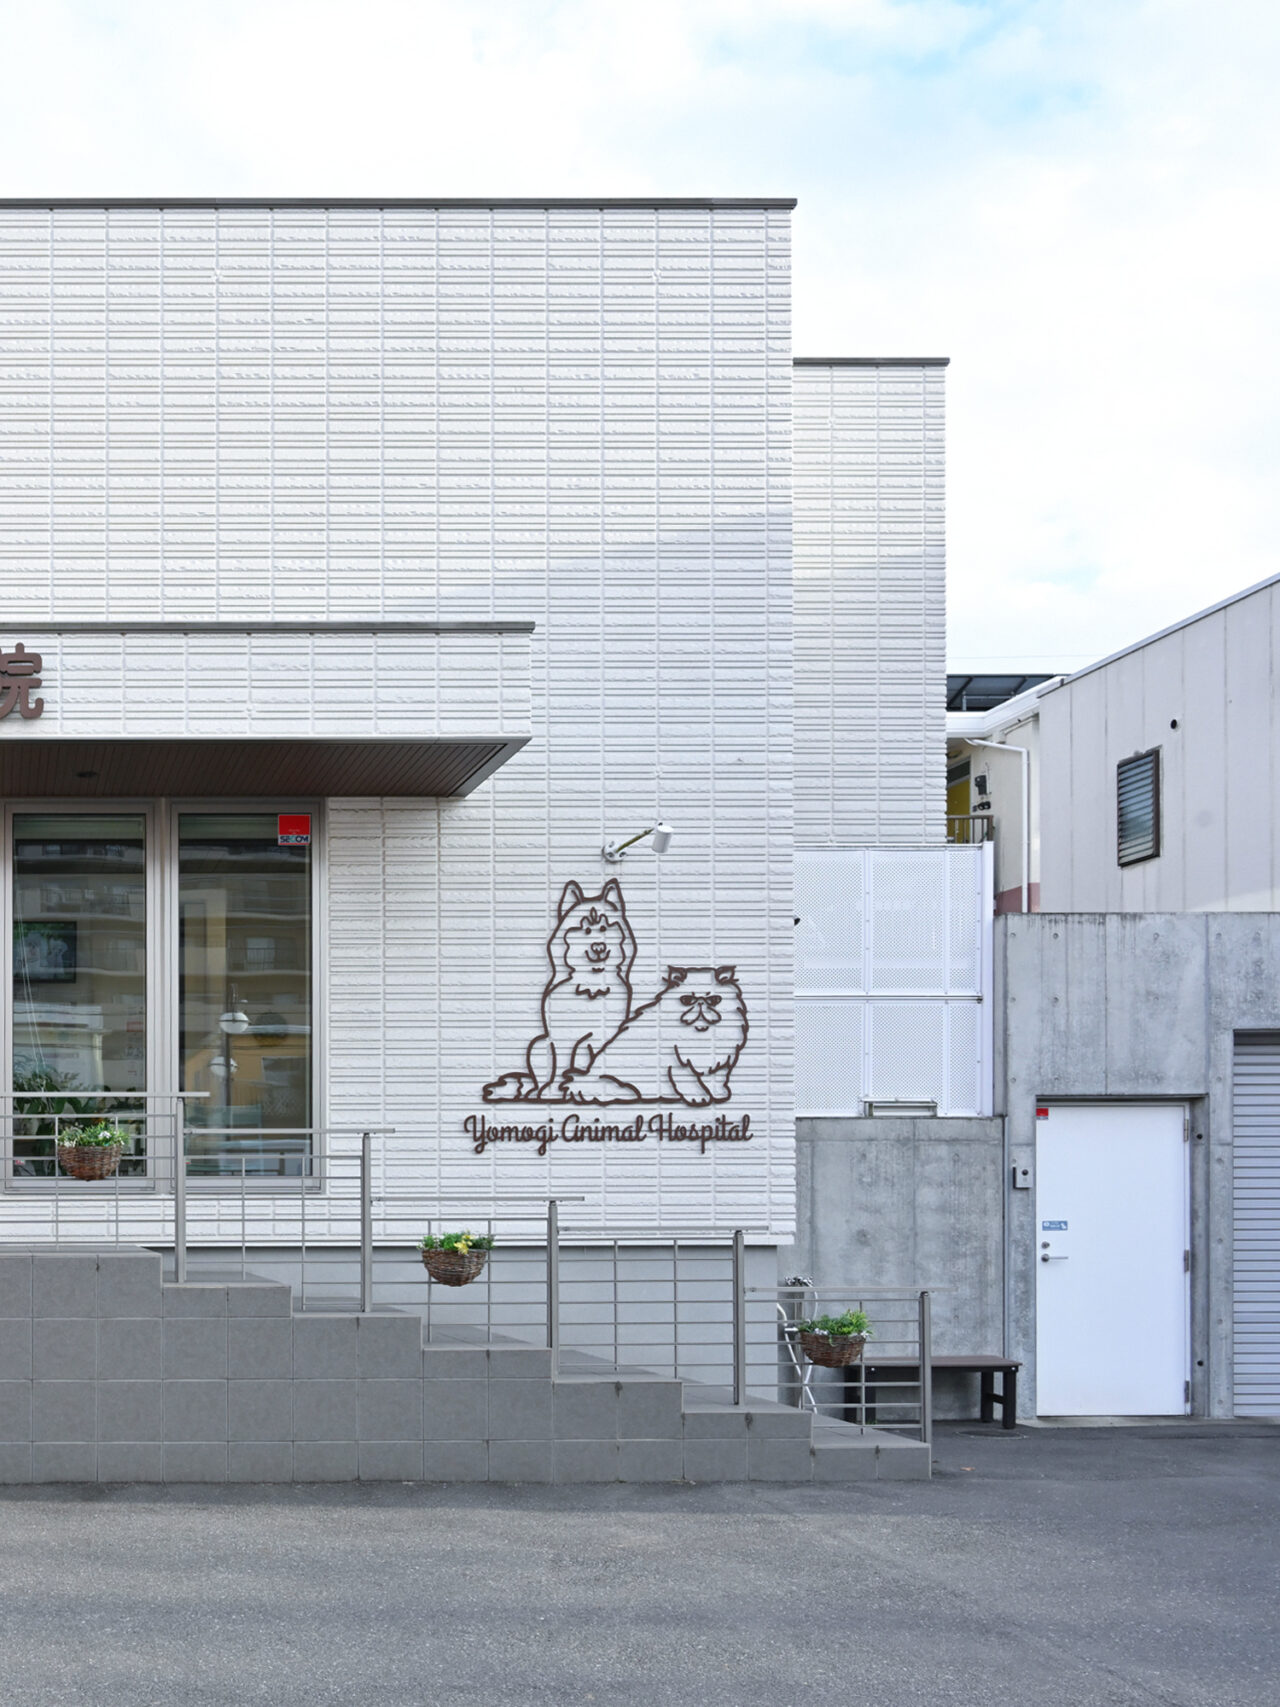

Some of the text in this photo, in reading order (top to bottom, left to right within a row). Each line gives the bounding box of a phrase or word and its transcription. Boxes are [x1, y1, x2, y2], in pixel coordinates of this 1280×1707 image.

[464, 1112, 753, 1156] Yomogi Animal Hospital
